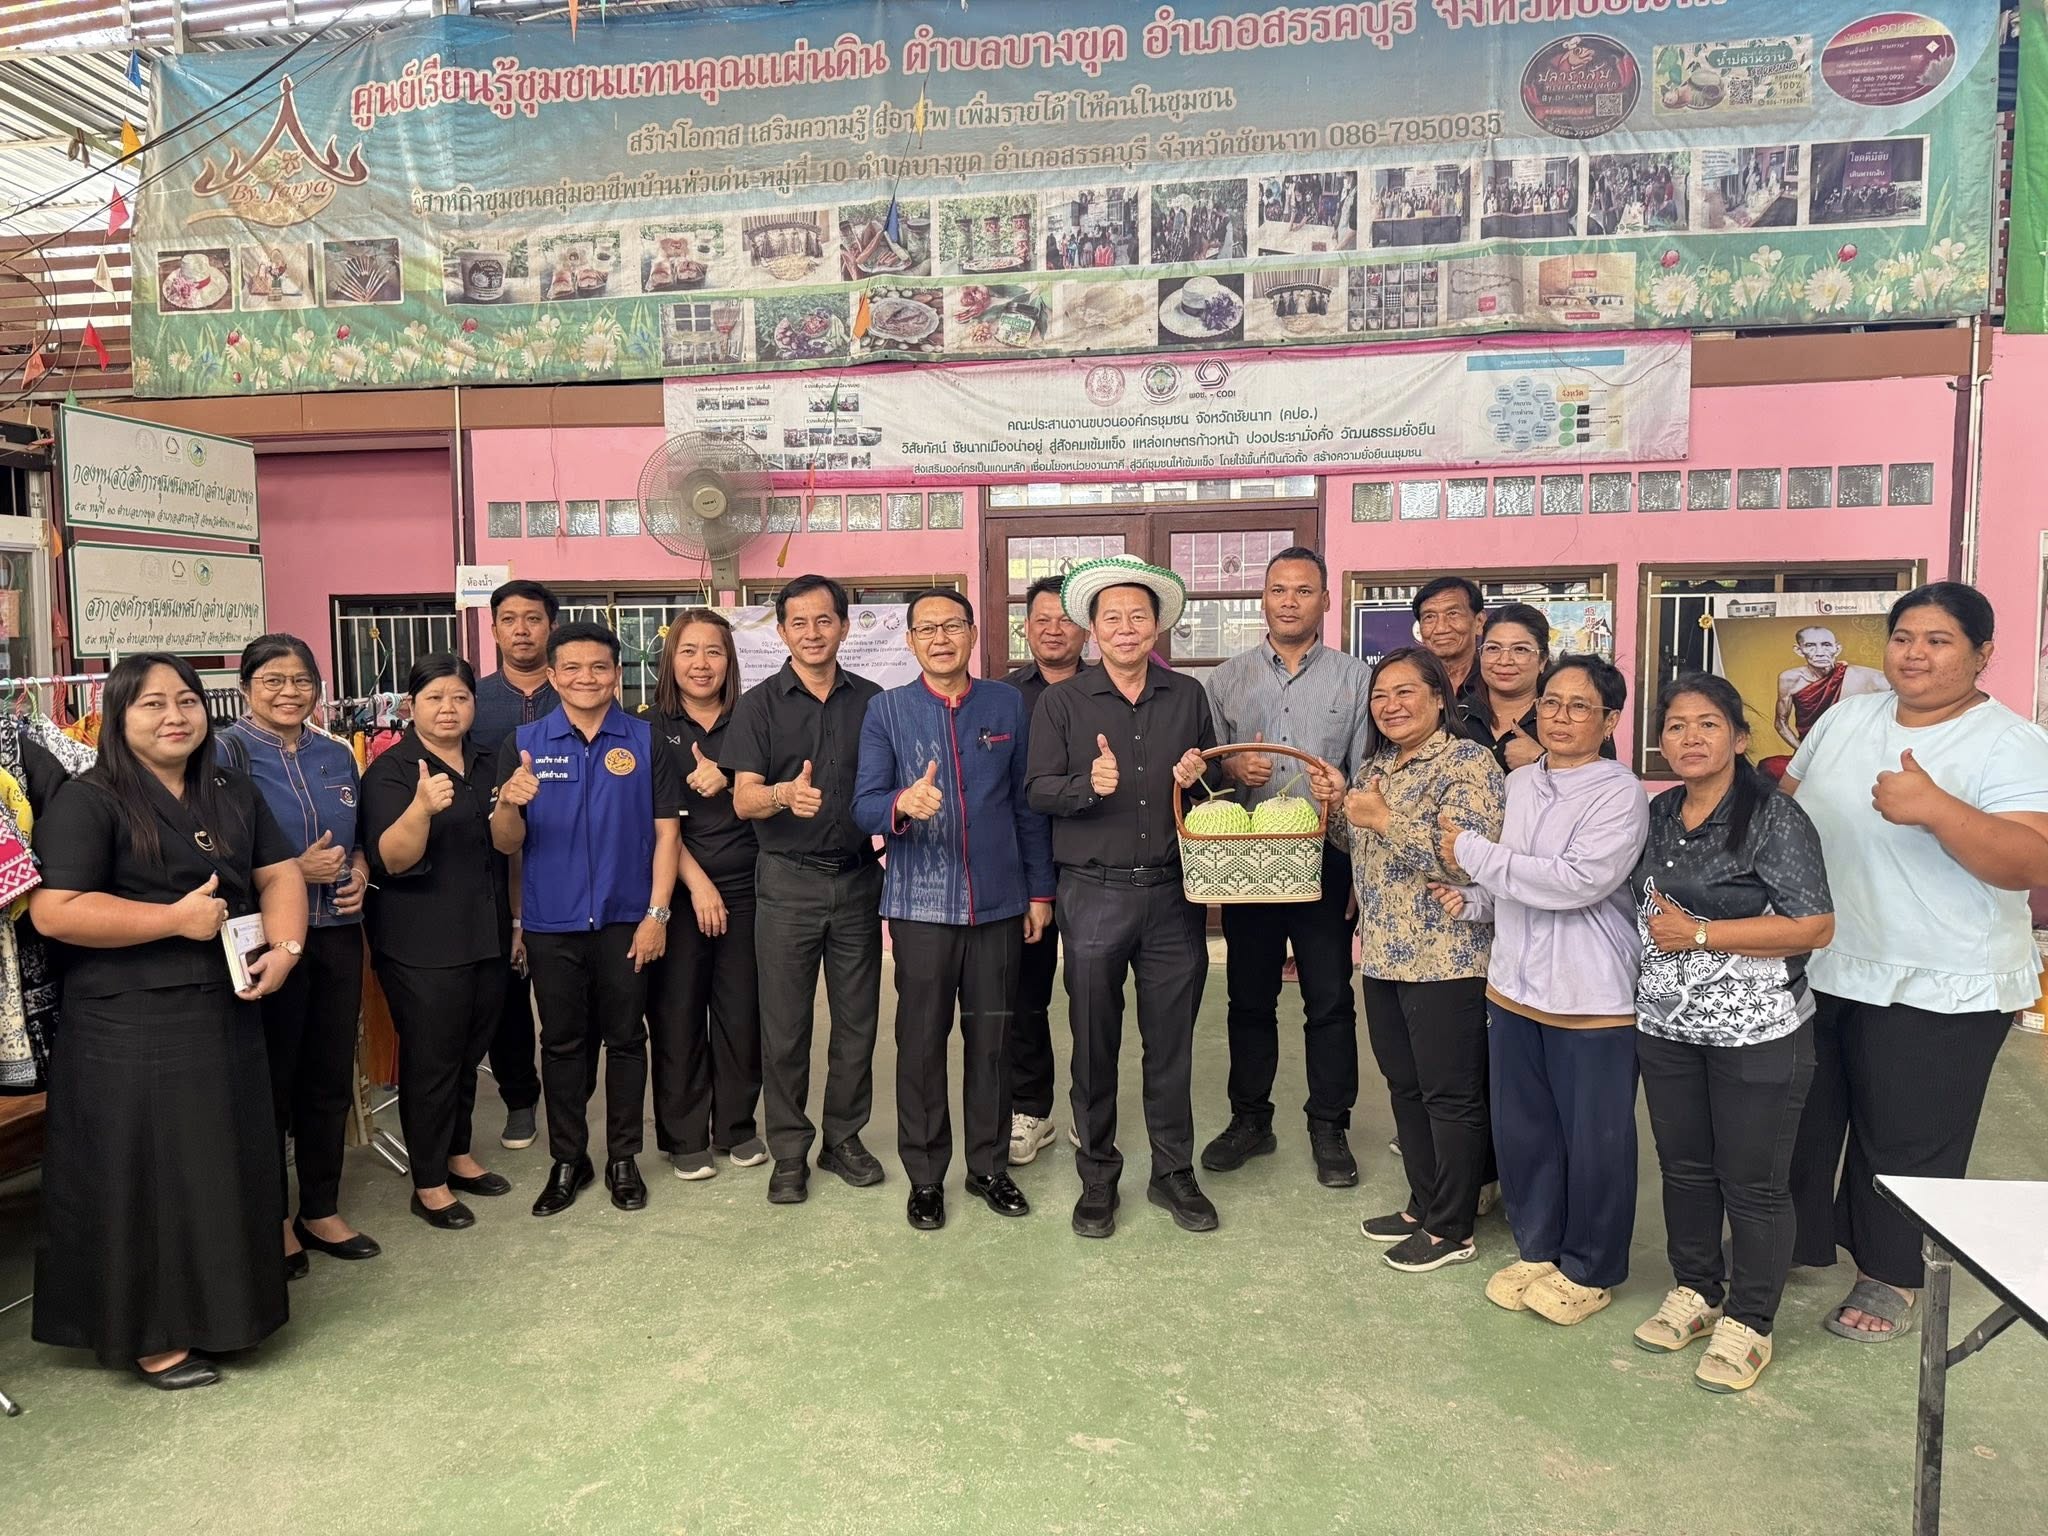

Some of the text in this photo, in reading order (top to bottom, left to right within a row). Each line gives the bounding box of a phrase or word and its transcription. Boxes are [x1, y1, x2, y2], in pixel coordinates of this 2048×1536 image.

[353, 35, 887, 128] ศูนย์เรียนรู้ชุมชนแทนคุณแผ่นดิน
[905, 27, 1125, 74] ตำบลบางขุด
[630, 121, 740, 152] สร้างโอกาส
[751, 110, 867, 143] เสริมความรู้
[959, 94, 1066, 126] เพิ่มรายได้
[1074, 87, 1233, 119] ให้คนในชุมชน
[760, 155, 808, 194] หมู่ที่
[820, 162, 847, 182] 10
[858, 152, 982, 182] ตำบลบางขุด
[994, 136, 1148, 170] อำเภอสรรคบุรี
[1159, 129, 1317, 159] จังหวัดชัยนาท
[1329, 113, 1502, 147] 086-7950935
[1216, 390, 1236, 398] CODI
[1007, 407, 1318, 431] คณะประสานงานขบวนองค์กรชุมชน จังหวัดชัยนาท (คปอ.)
[902, 419, 1436, 457] วิสัยทัศน์ ชัยนาทเมืองน่าอยู่ สู่สังคมเข้มแข็ง แหล่งเกษตรก้าวหน้า ปวงประชามั่งคั่ง วัฒนธรรมยั่งยืน
[914, 461, 1026, 474] ส่งเสริมองค์กรเป็นแกนหลัก
[1030, 459, 1125, 472] เชื่อมโยงหน่วยงานภาคี
[467, 573, 493, 587] ห้องน้ำ
